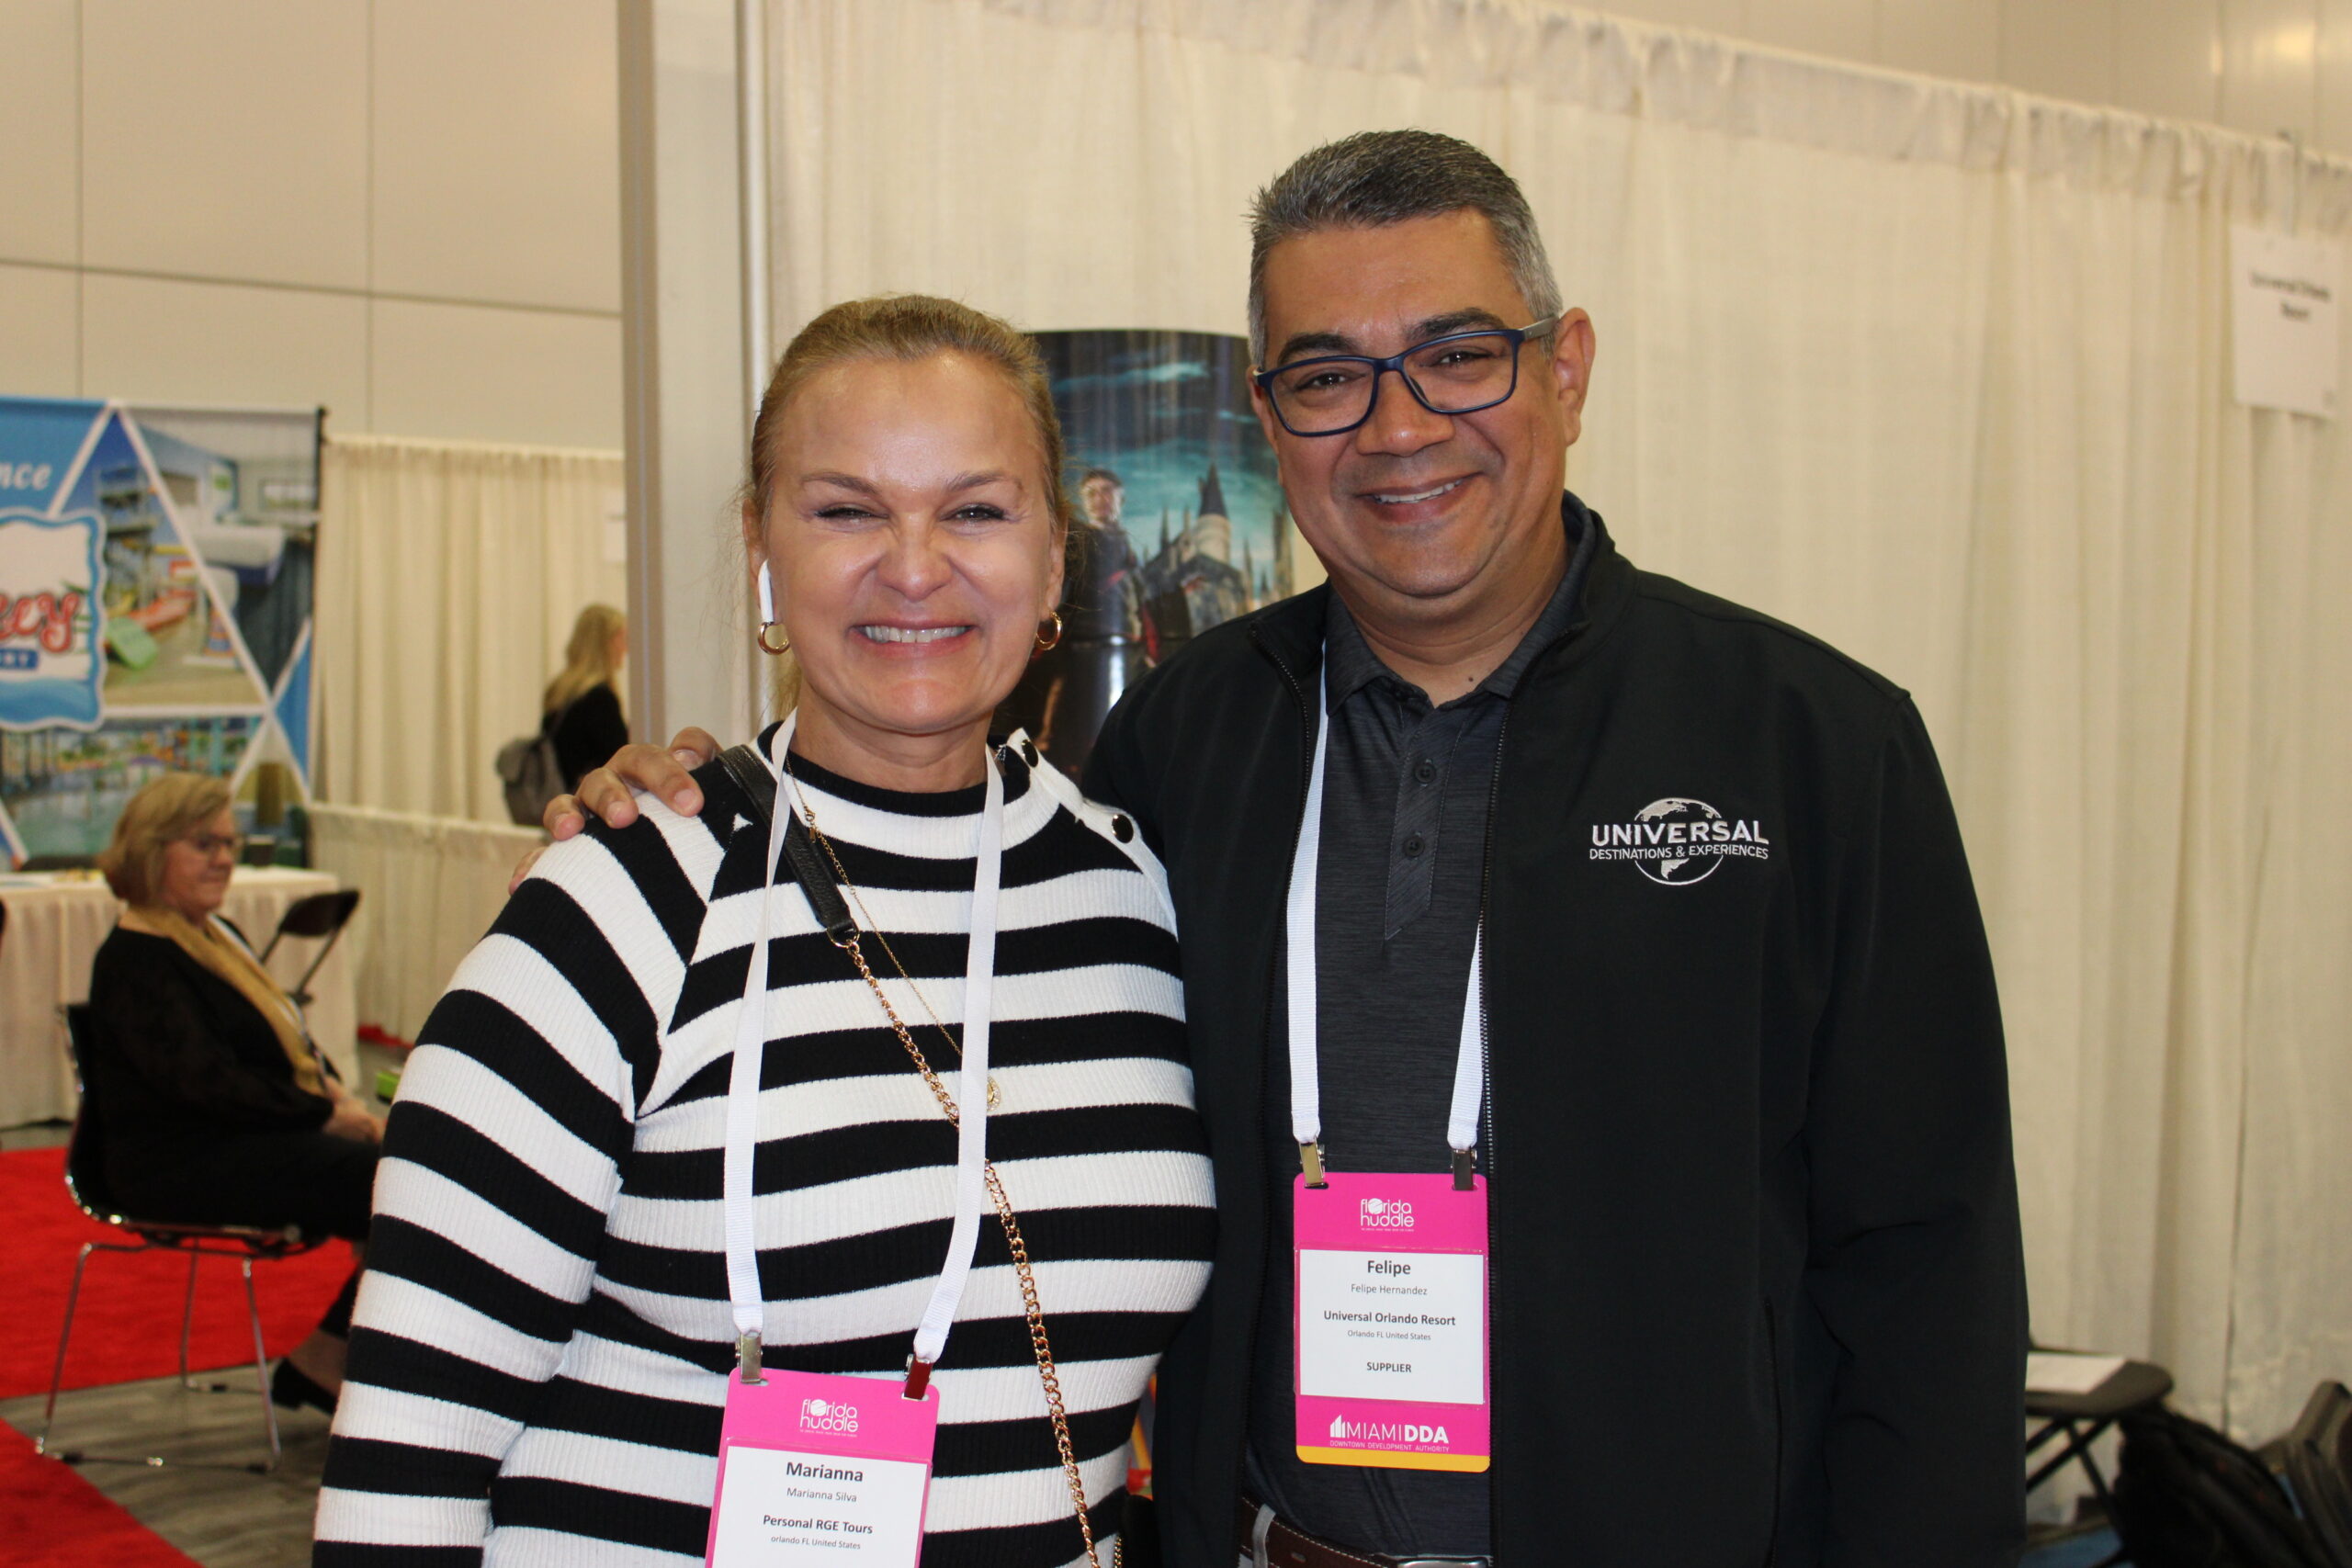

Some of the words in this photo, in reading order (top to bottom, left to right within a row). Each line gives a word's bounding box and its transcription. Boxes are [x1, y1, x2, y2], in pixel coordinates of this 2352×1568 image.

[1592, 820, 1770, 846] UNIVERSAL
[1589, 847, 1672, 860] DESTINATIONS
[1676, 845, 1685, 858] &
[1689, 844, 1769, 860] EXPERIENCES
[1361, 1198, 1412, 1214] florida
[1361, 1213, 1414, 1227] huddle
[1367, 1259, 1411, 1278] Felipe
[1351, 1283, 1377, 1294] Felipe
[1379, 1285, 1428, 1295] Hernandez
[1324, 1310, 1372, 1322] Universal
[1374, 1313, 1419, 1325] Orlando
[1420, 1314, 1456, 1325] Resort
[1347, 1330, 1374, 1338] Orlando
[1409, 1333, 1431, 1341] States
[1366, 1361, 1412, 1373] SUPPLIER
[801, 1398, 858, 1419] florida
[799, 1416, 859, 1433] huddle
[1347, 1421, 1449, 1444] MIAMIDDA
[1329, 1439, 1365, 1449] DOWNTOWN
[1367, 1442, 1412, 1450] DEVELOPMENT
[1415, 1444, 1450, 1452] AUTHORITY
[786, 1461, 864, 1482] Marianna
[786, 1487, 832, 1500] Marianna
[835, 1491, 857, 1503] Silva
[763, 1514, 813, 1529] Personal
[816, 1519, 839, 1531] RGE
[842, 1521, 873, 1535] Tours
[771, 1535, 800, 1544] orlando
[802, 1537, 809, 1545] FL
[811, 1539, 837, 1548] United
[838, 1540, 861, 1550] States
